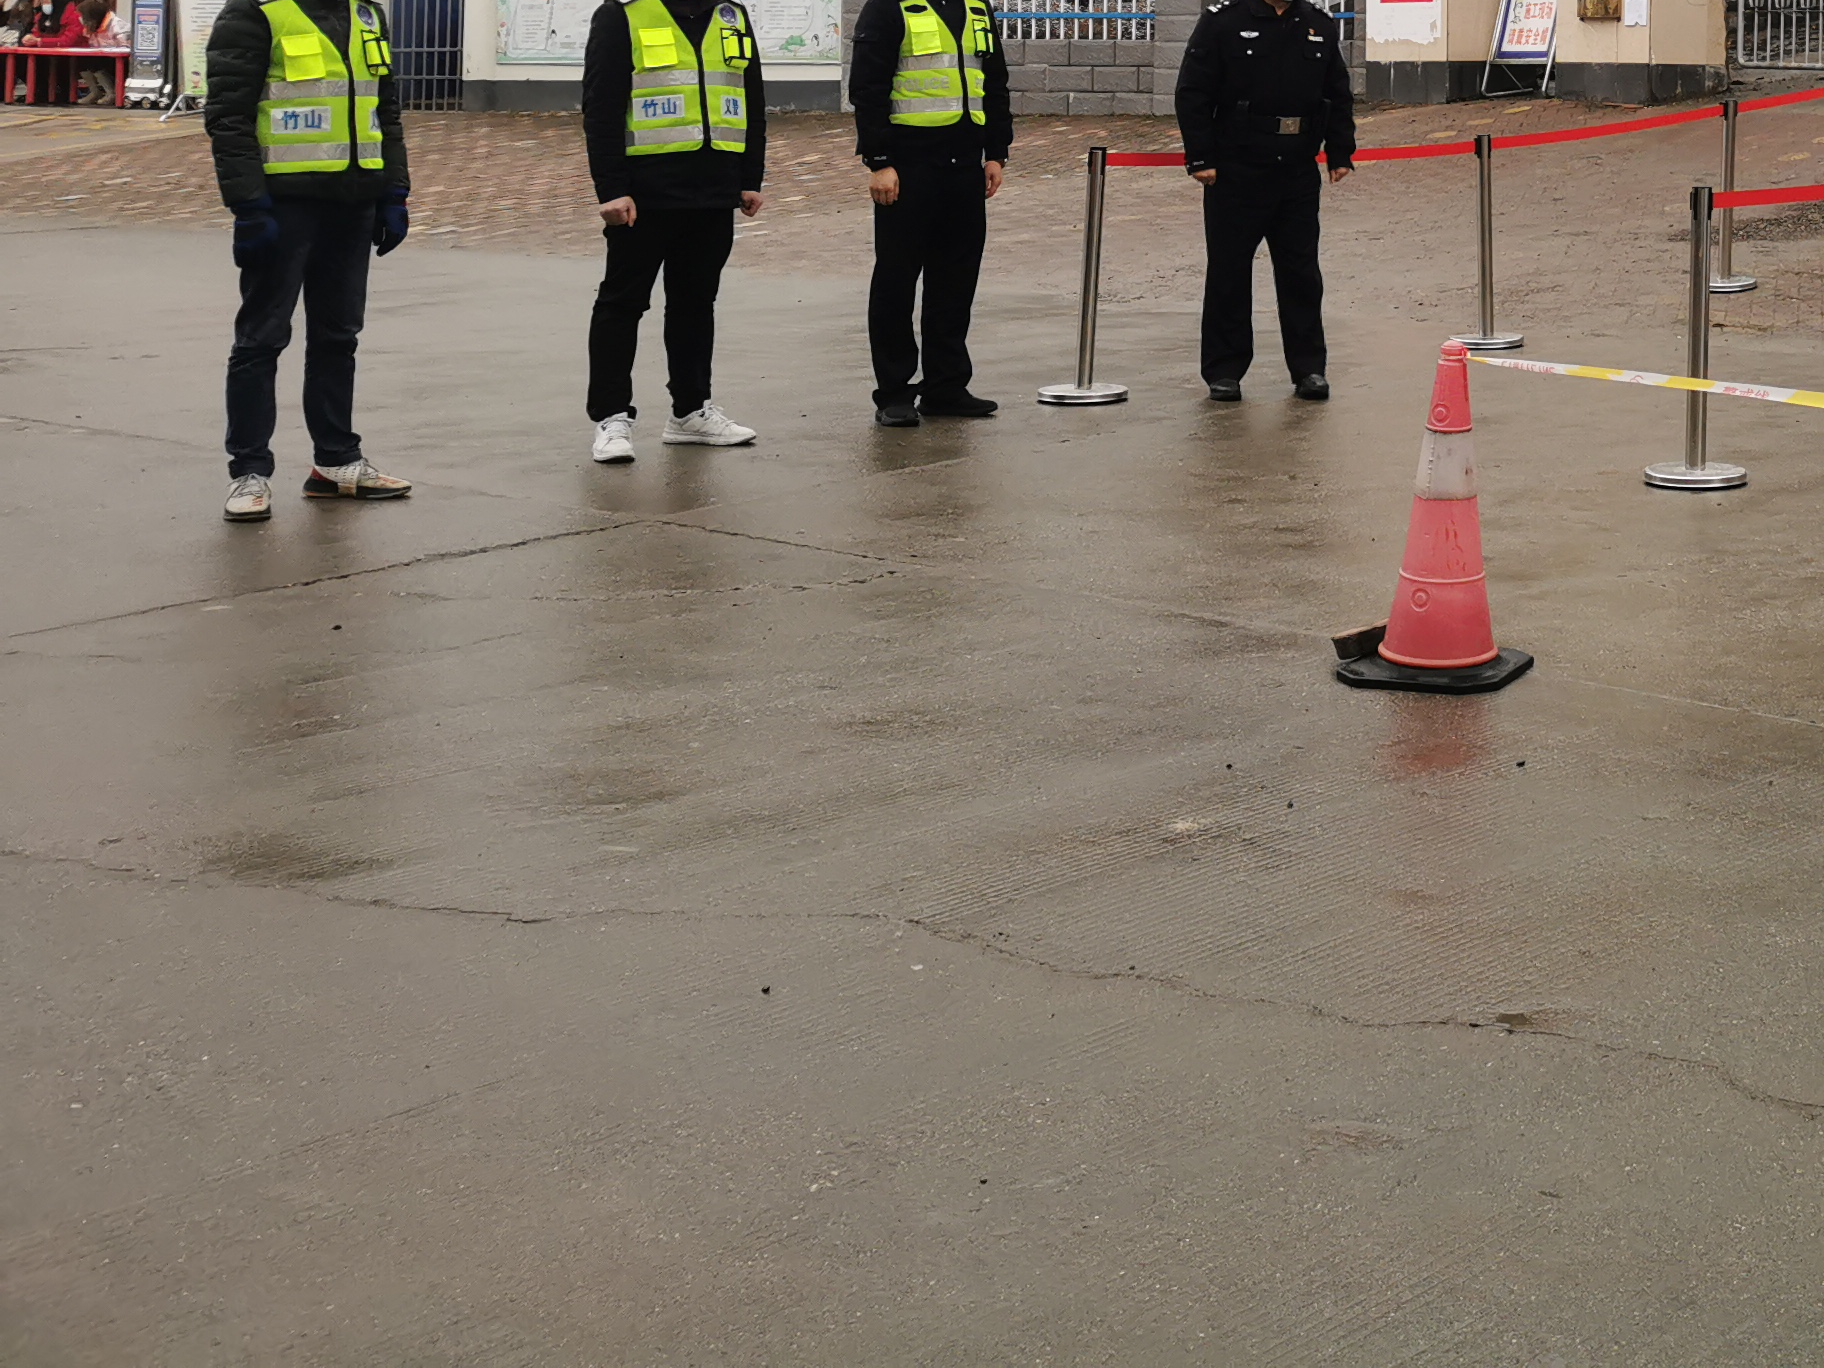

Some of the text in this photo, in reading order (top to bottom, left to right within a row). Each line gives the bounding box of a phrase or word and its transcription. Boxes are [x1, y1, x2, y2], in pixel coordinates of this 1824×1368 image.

[1523, 2, 1554, 20] 施工现场
[1507, 27, 1550, 46] 请戴安全帽
[642, 98, 677, 117] 竹山
[281, 110, 323, 130] 竹山
